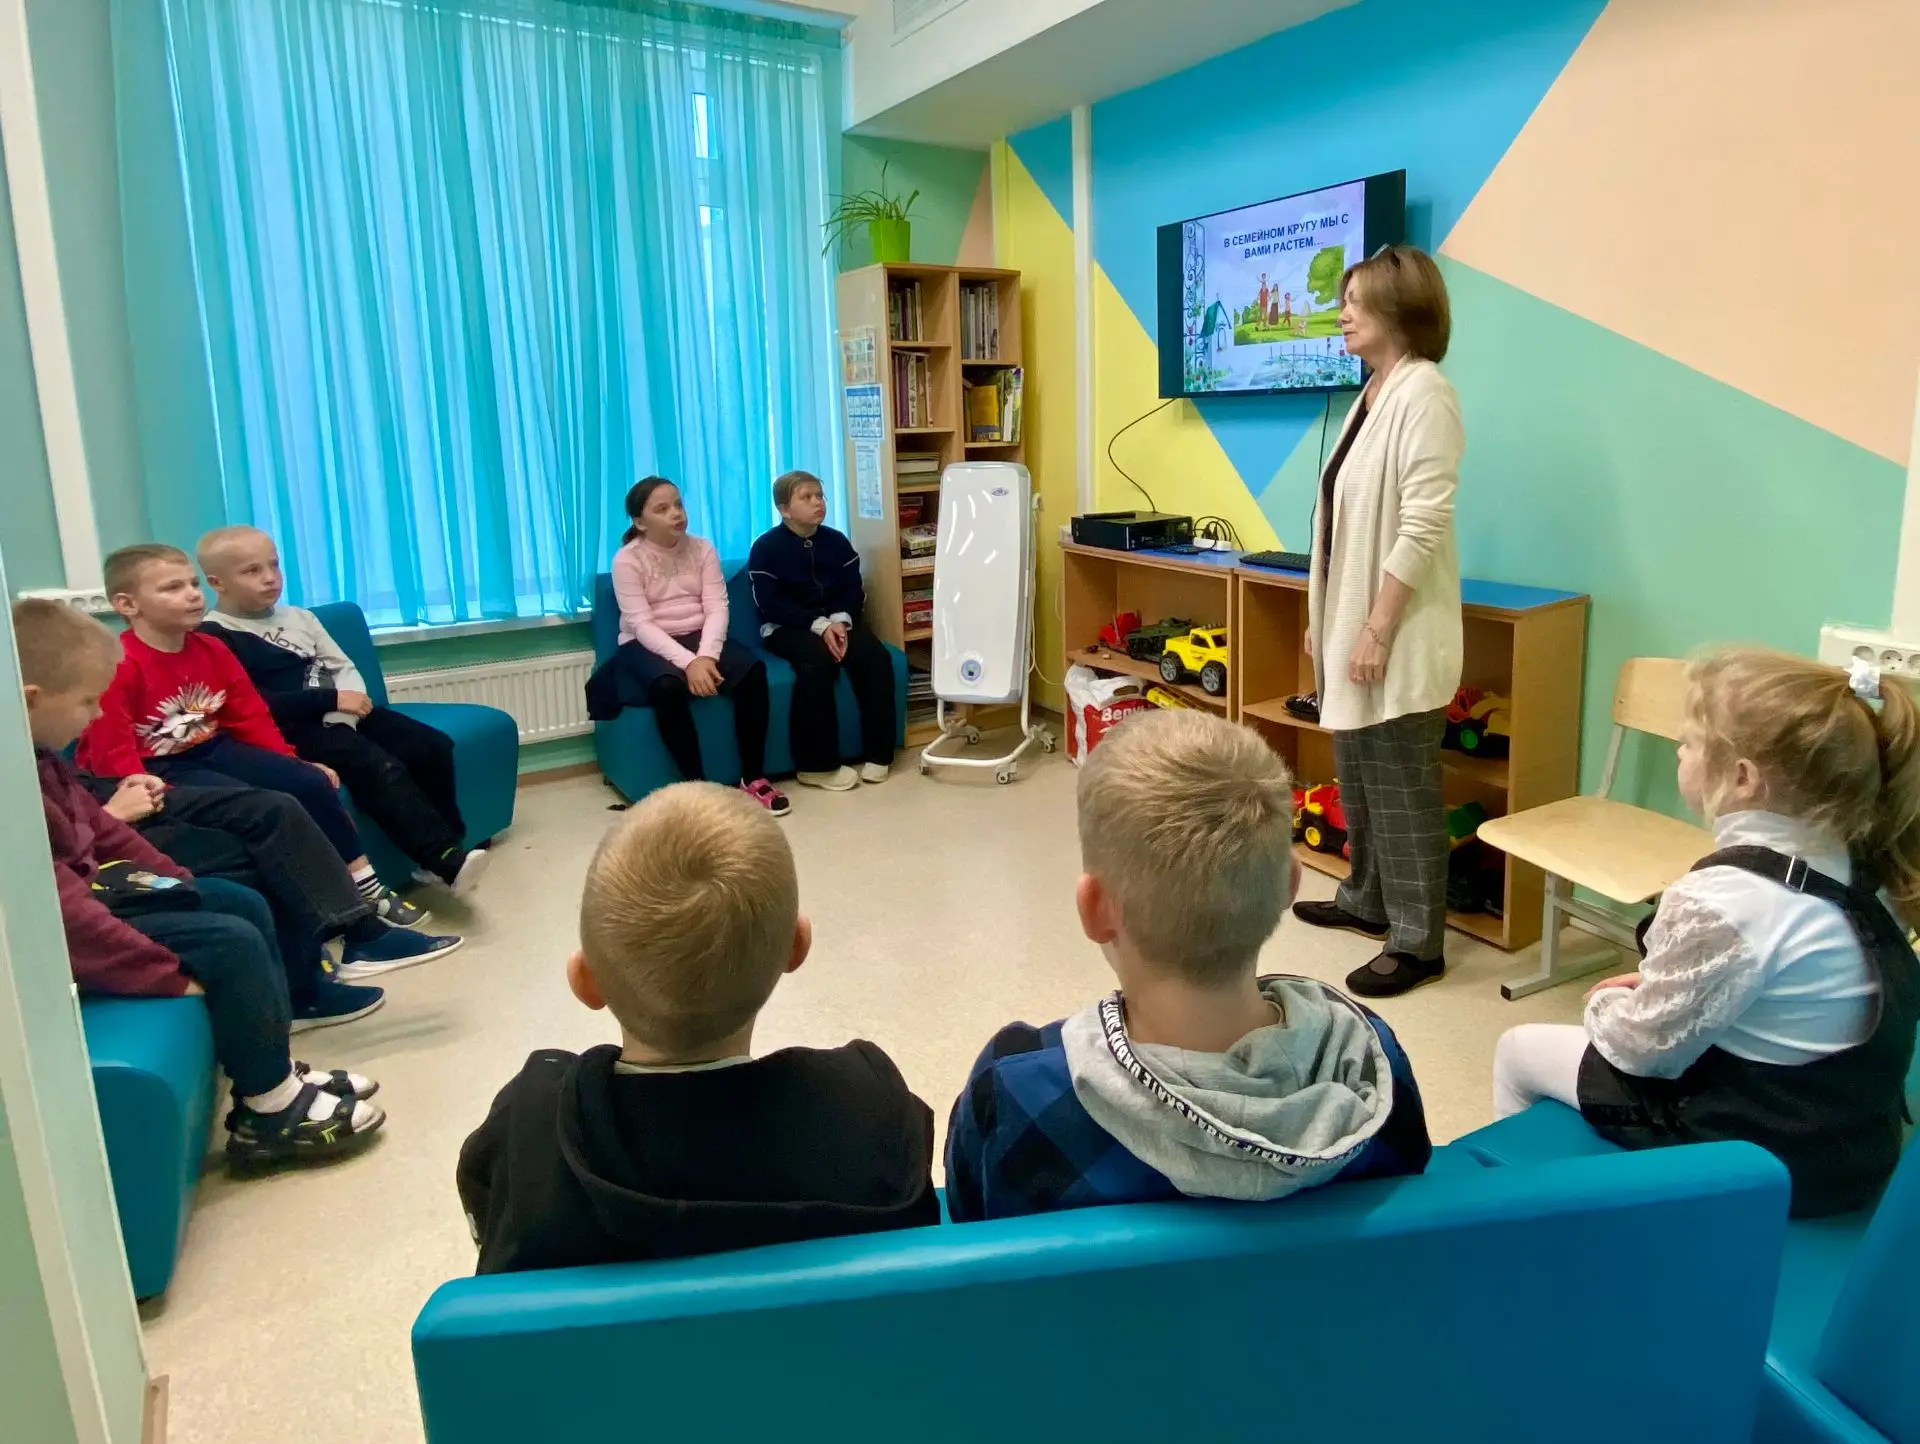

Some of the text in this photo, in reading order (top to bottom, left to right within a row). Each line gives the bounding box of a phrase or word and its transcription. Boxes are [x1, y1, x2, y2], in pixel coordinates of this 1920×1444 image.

[1224, 213, 1349, 248] В СЕМЕЙНОМ КРУГУ МЫ С
[1244, 244, 1271, 259] ВАМИ
